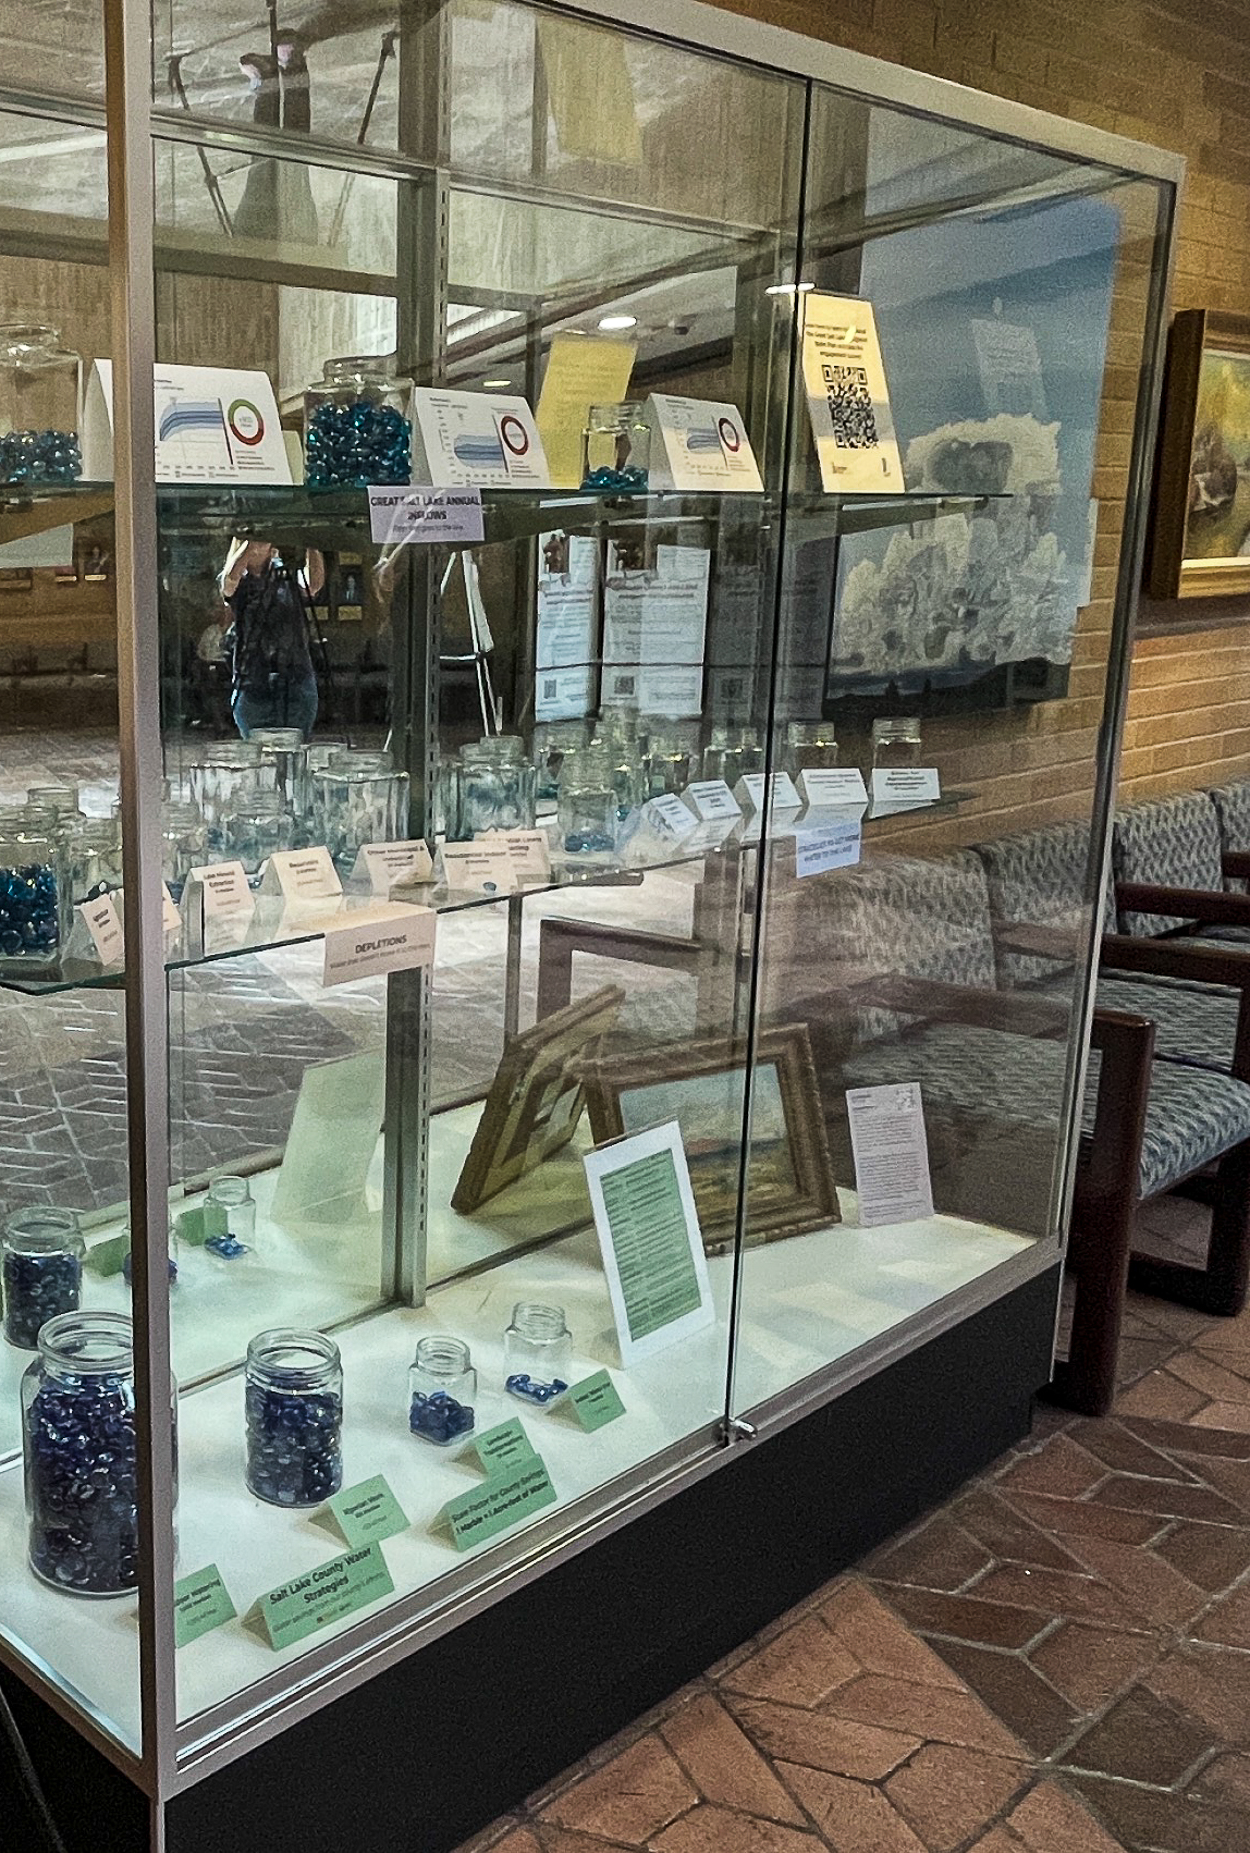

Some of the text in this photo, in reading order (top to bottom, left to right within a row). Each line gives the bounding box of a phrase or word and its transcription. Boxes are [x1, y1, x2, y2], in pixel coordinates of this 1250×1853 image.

[355, 935, 408, 954] DEPLETIONS
[270, 1588, 290, 1605] Salt
[289, 1578, 311, 1595] Lake
[312, 1562, 344, 1582] County
[344, 1547, 370, 1566] Water
[303, 1575, 349, 1603] Strategies
